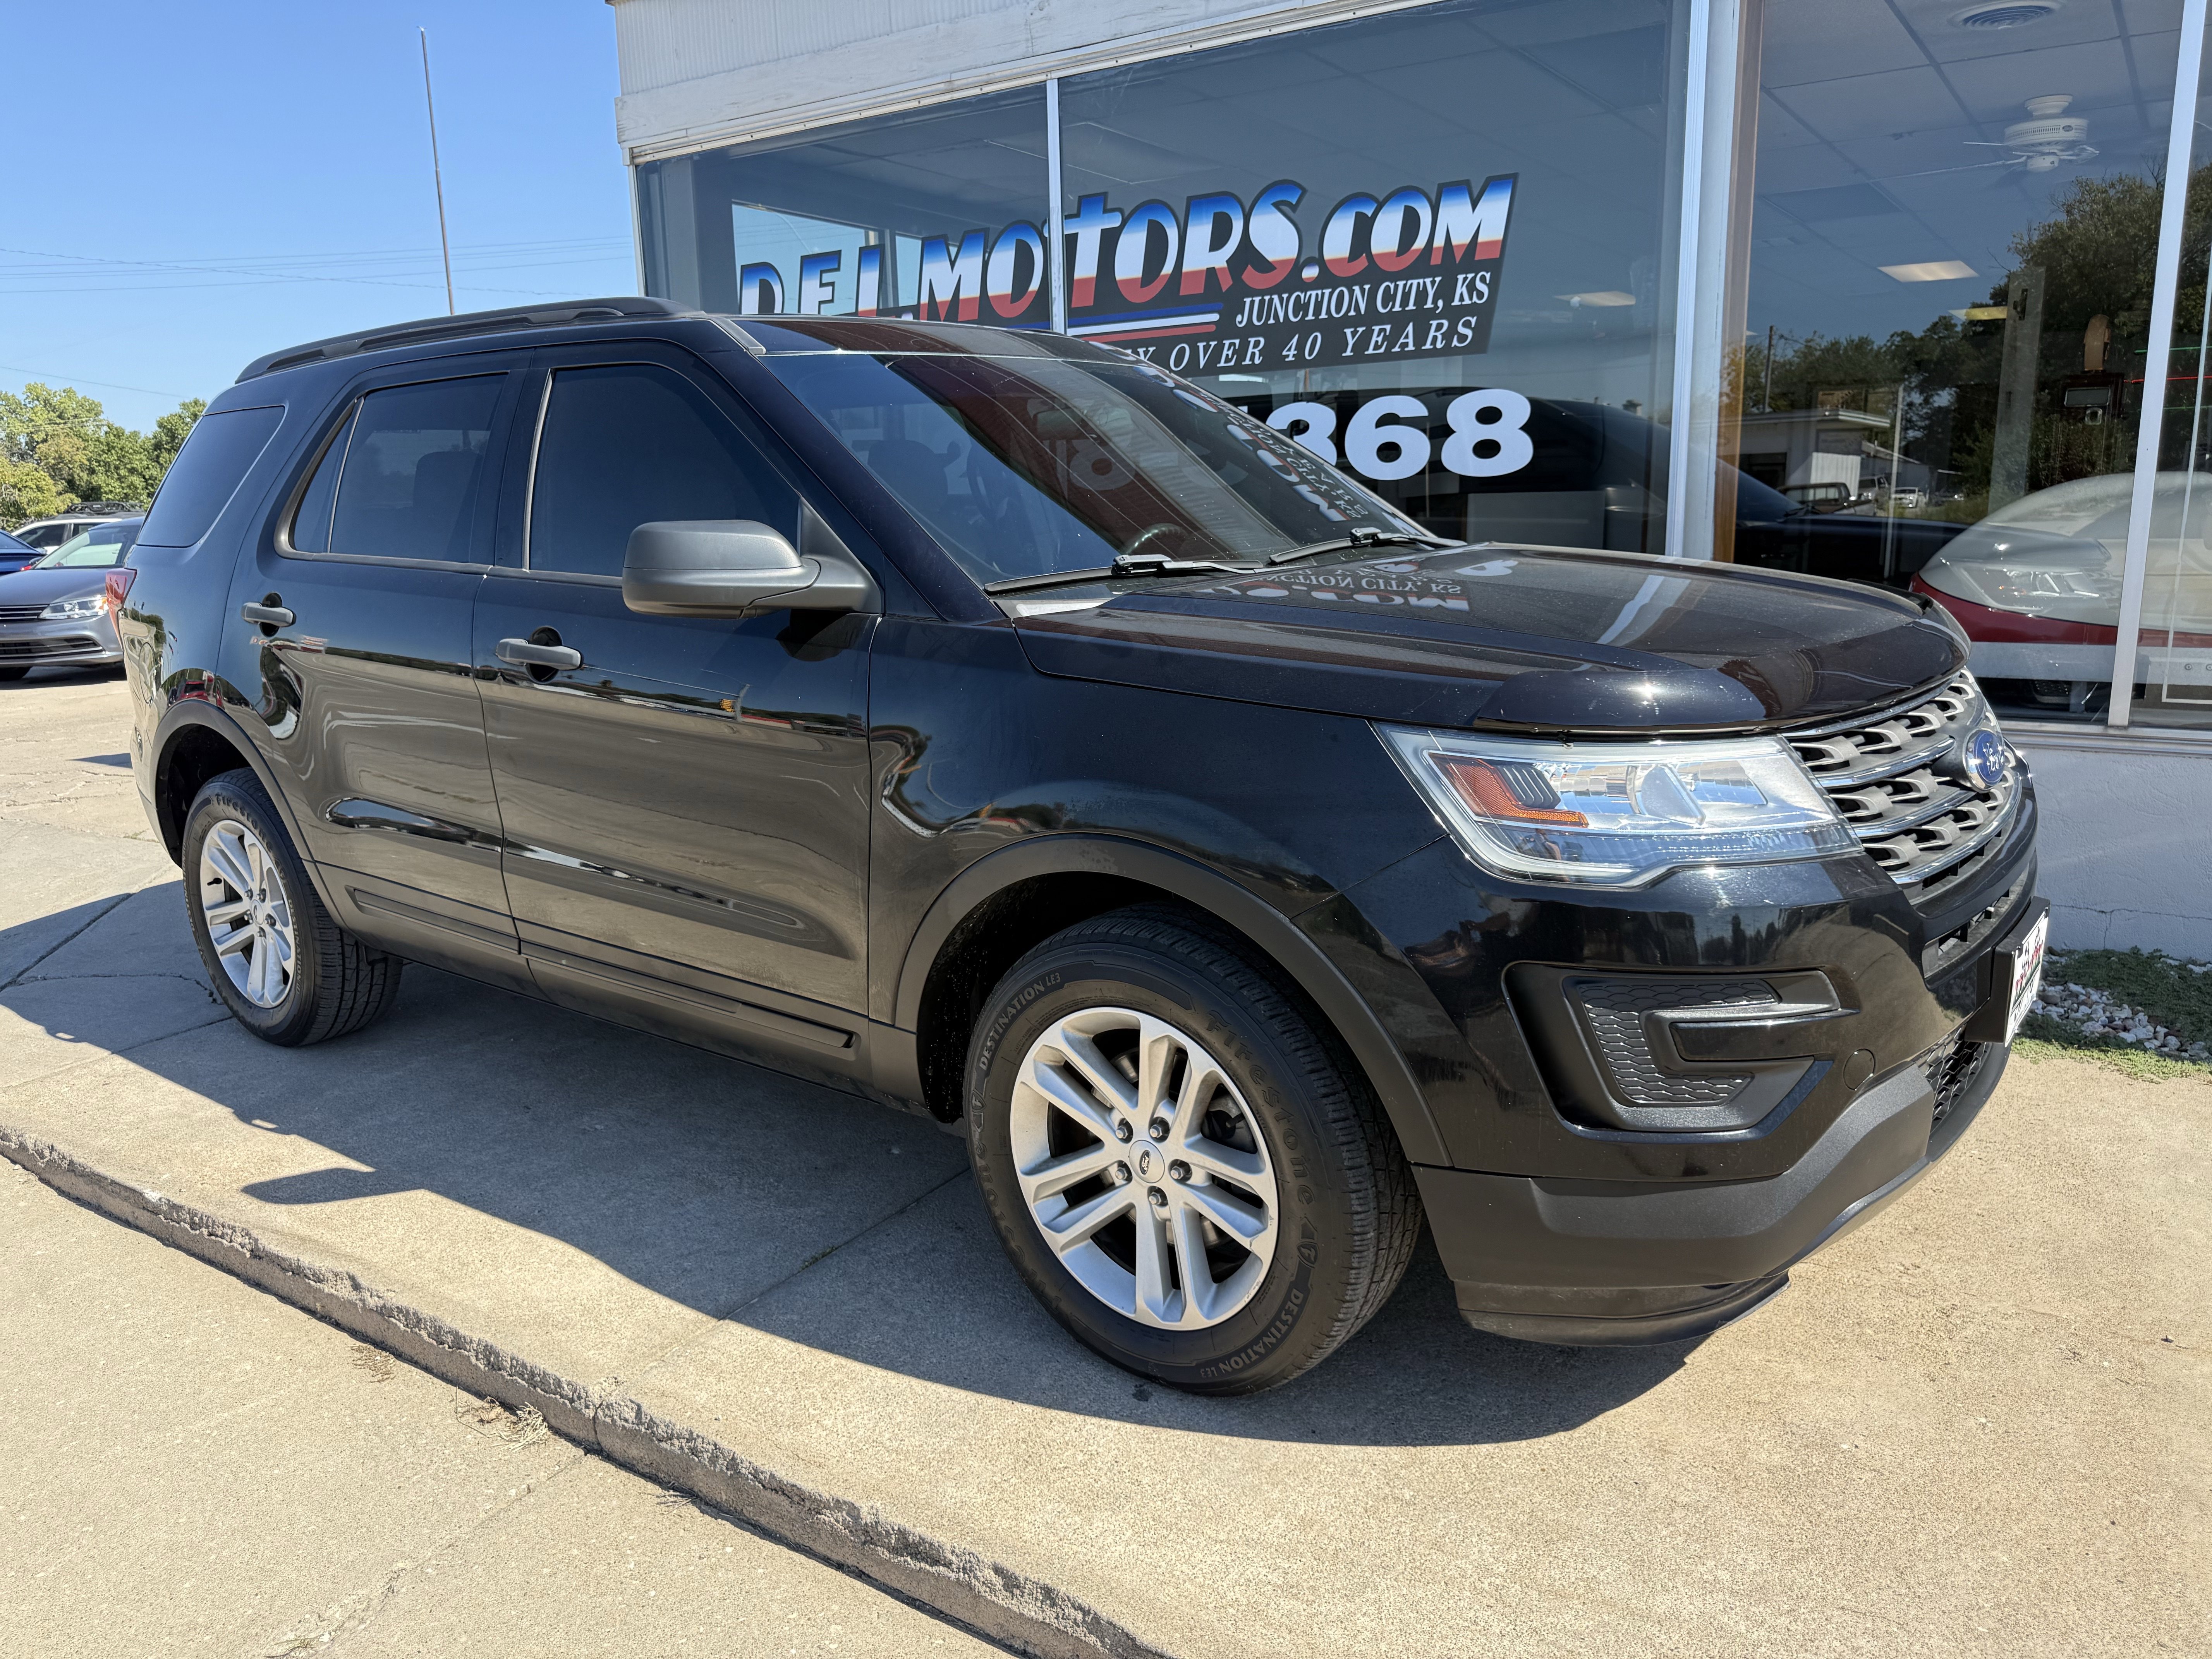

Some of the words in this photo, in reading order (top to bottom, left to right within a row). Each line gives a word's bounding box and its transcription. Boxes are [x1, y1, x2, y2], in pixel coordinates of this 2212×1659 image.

[1236, 284, 1371, 328] JUNCTION
[1376, 276, 1443, 314] CITY,
[1451, 271, 1491, 306] KS
[1169, 336, 1265, 371] OVER
[1281, 331, 1322, 361] 40
[1342, 316, 1477, 356] YEARS
[1237, 389, 1534, 480] 368
[979, 980, 1045, 1071] DESTINATION
[1046, 972, 1061, 986] LE3
[1205, 1010, 1316, 1206] Firestone
[1200, 1367, 1218, 1378] LE3
[1218, 1288, 1304, 1374] DESTINATION
